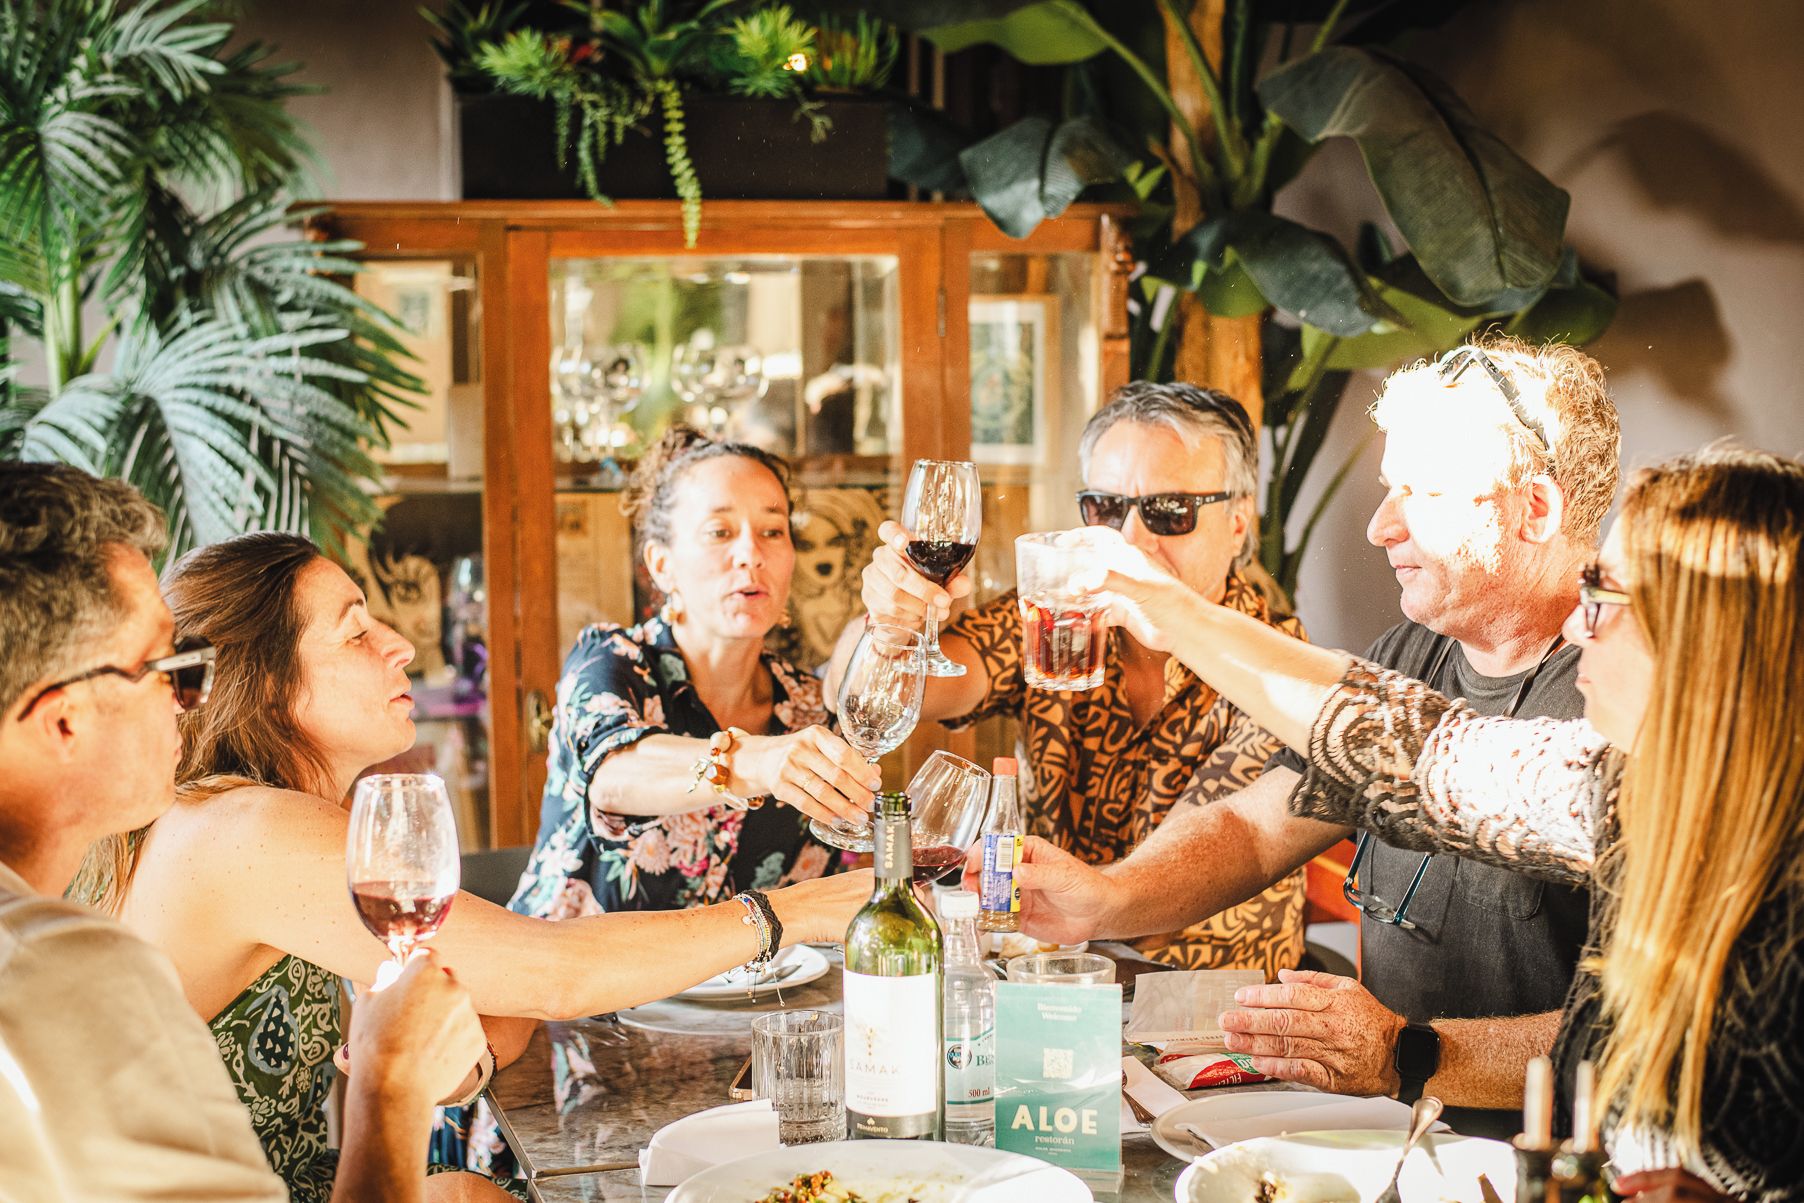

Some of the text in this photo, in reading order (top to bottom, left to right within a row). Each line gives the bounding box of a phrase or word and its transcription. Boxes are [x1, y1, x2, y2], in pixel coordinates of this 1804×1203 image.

[884, 825, 895, 869] SAMAK
[968, 1087, 991, 1098] 500 ml
[1011, 1104, 1098, 1135] ALOE
[1035, 1135, 1075, 1145] restorán
